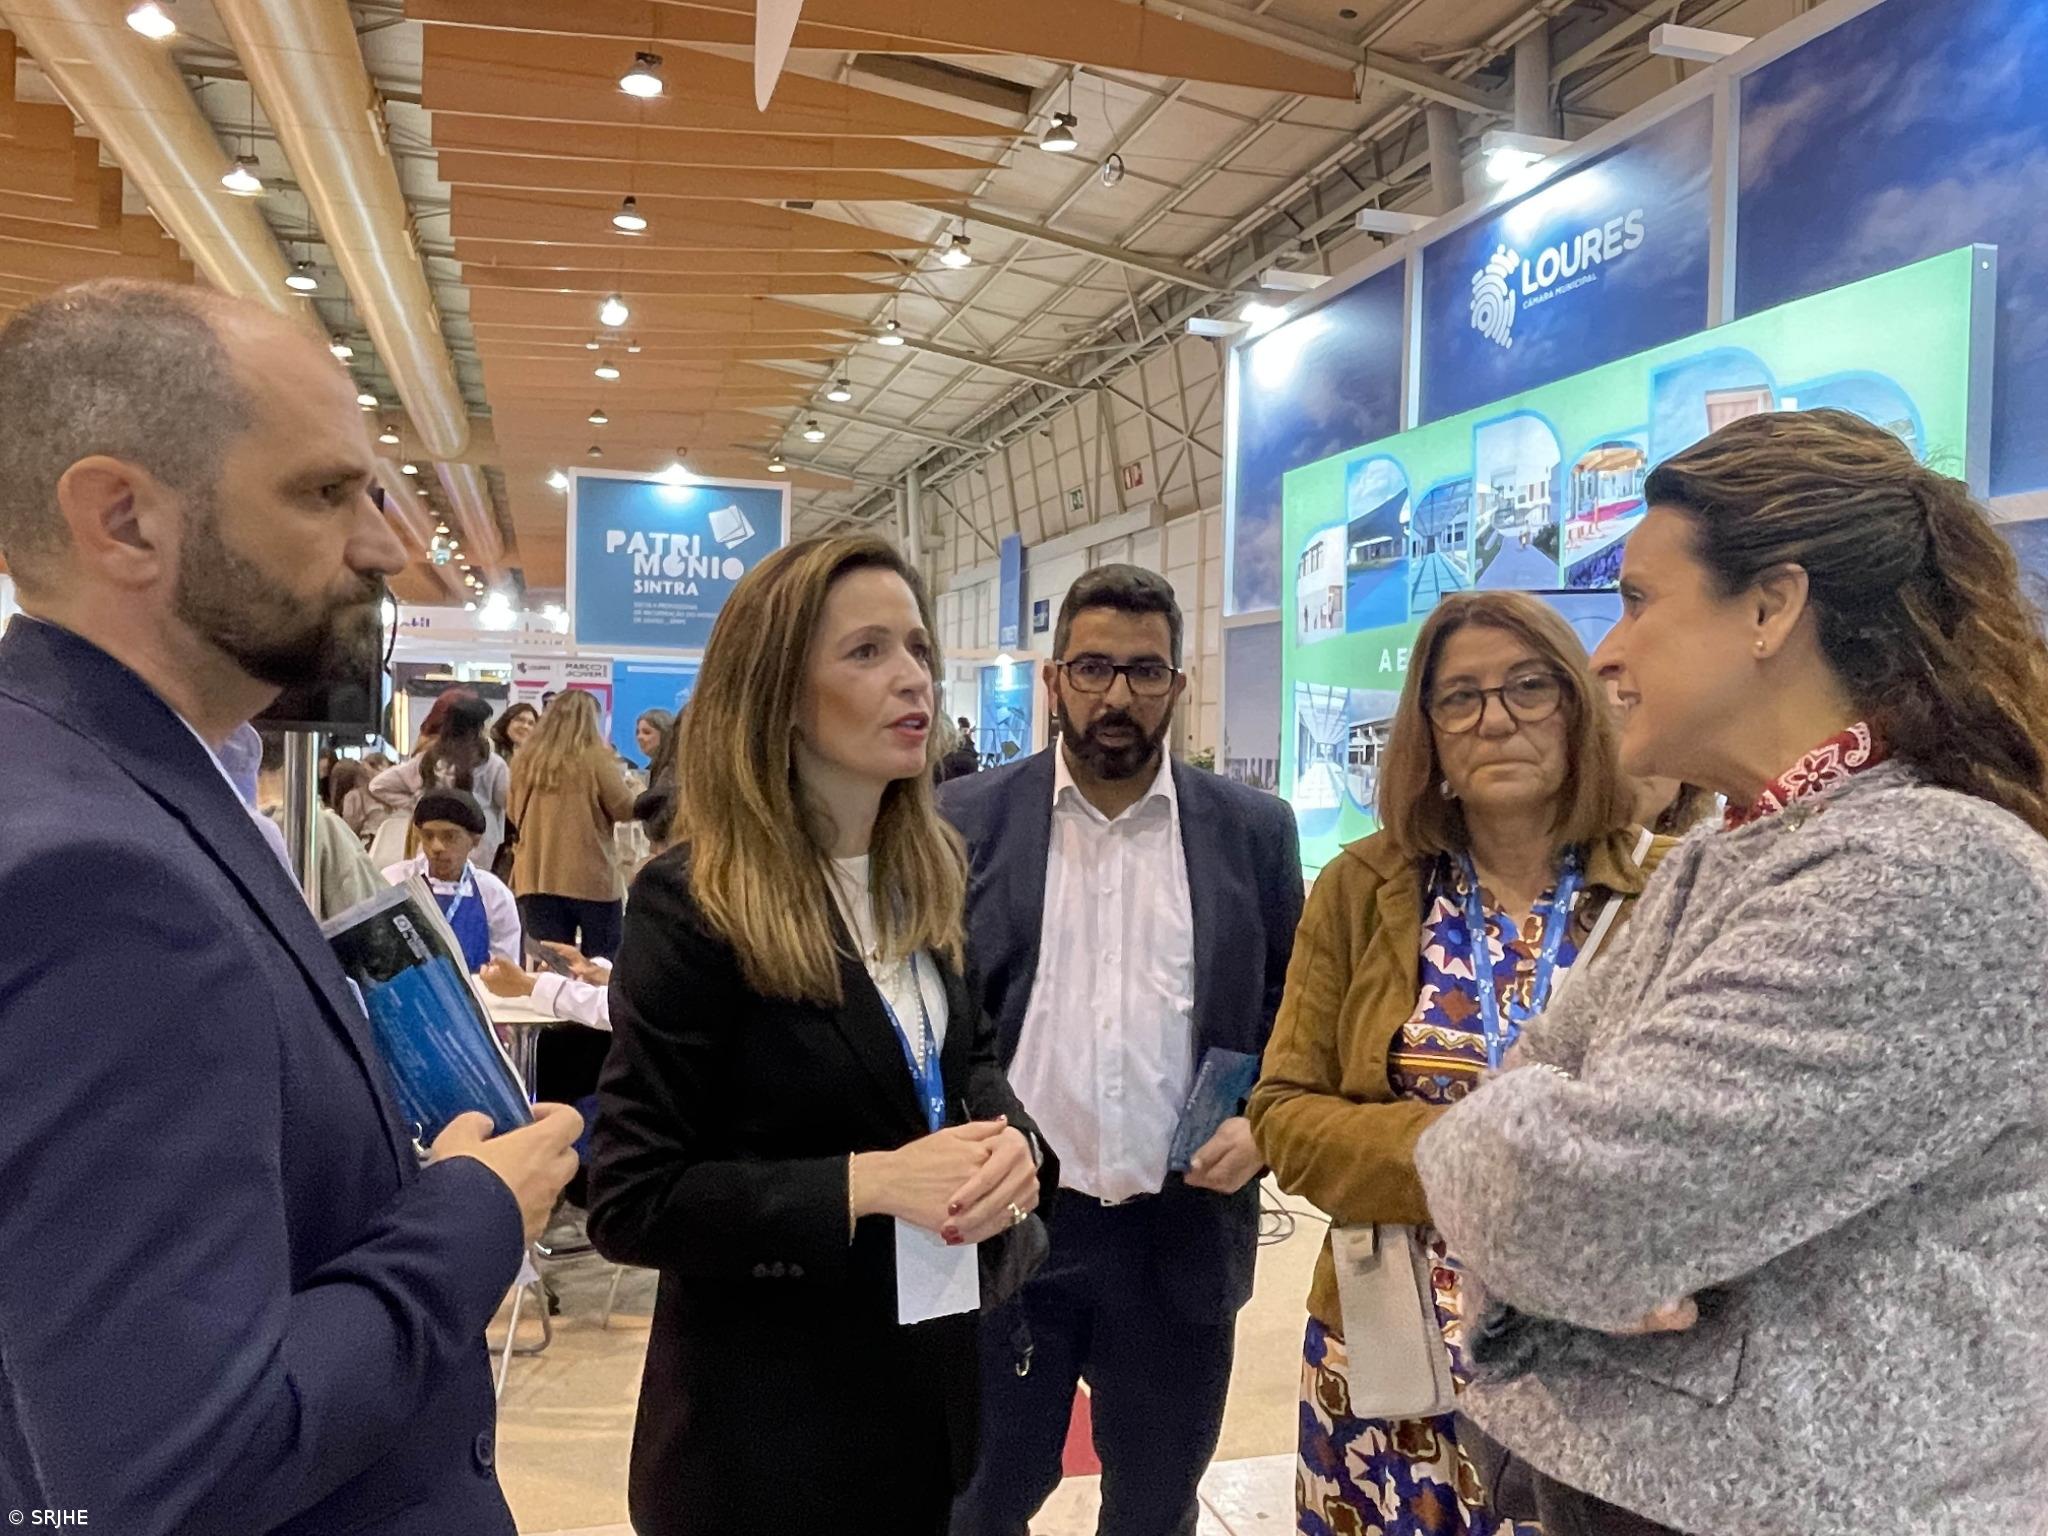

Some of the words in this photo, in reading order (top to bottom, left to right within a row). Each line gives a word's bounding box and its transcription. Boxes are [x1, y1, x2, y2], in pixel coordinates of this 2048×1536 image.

[1521, 208, 1645, 295] LOURES
[606, 529, 701, 557] PATRI
[632, 579, 699, 596] SINTRA
